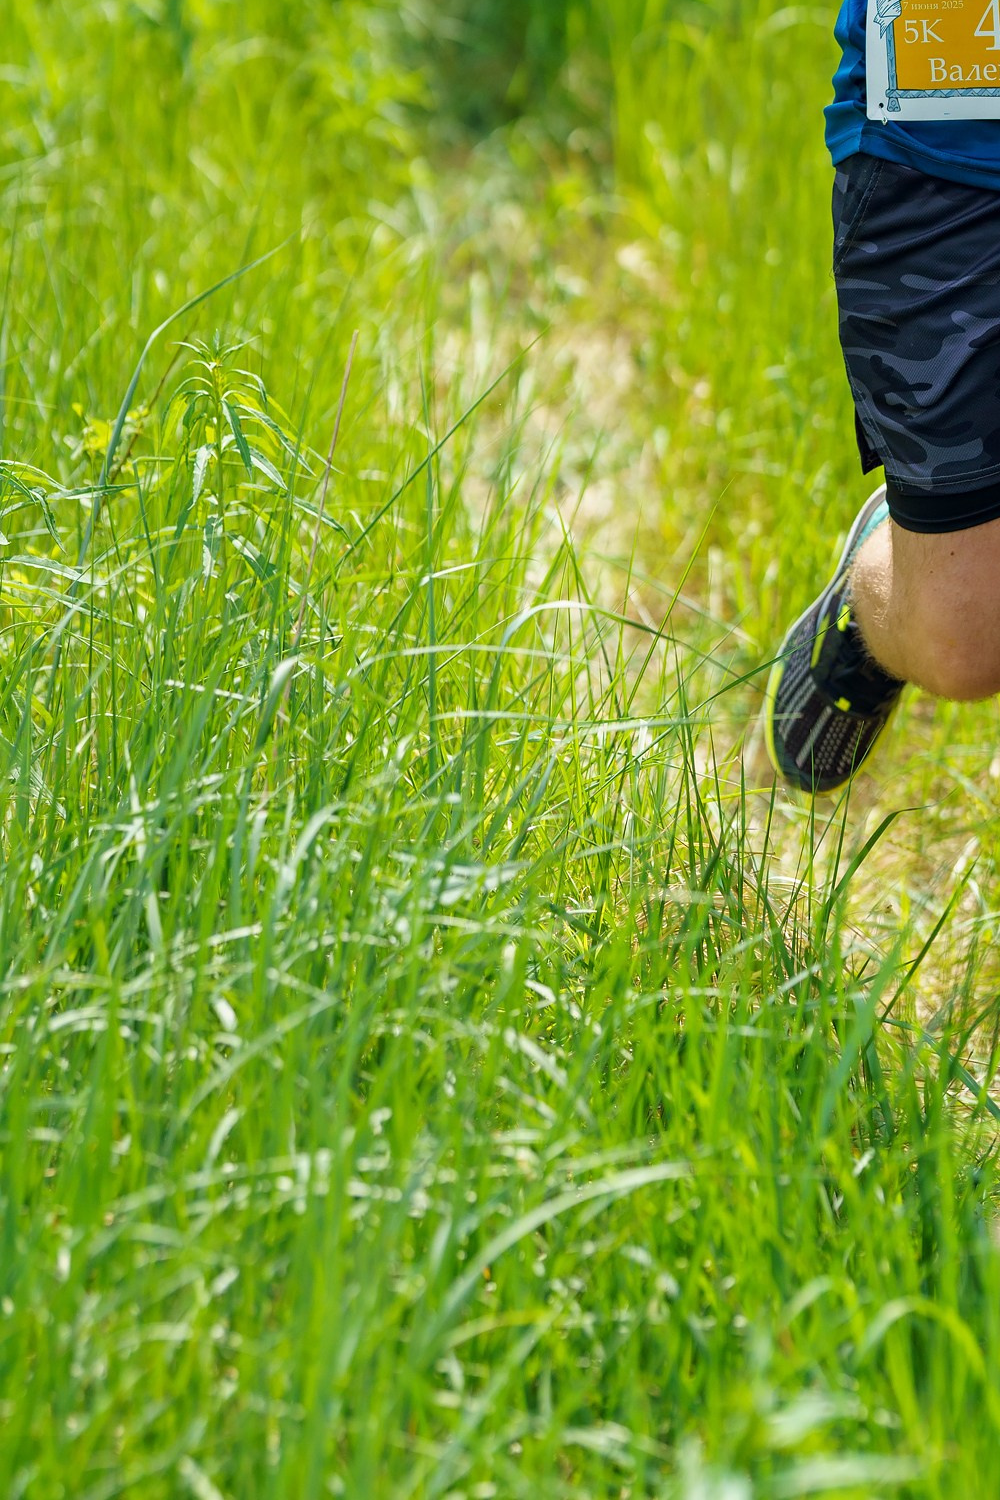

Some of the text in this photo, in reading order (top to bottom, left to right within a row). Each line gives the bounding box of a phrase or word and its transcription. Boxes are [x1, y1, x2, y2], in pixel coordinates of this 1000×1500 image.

[903, 0, 964, 11] 7 июня 2025
